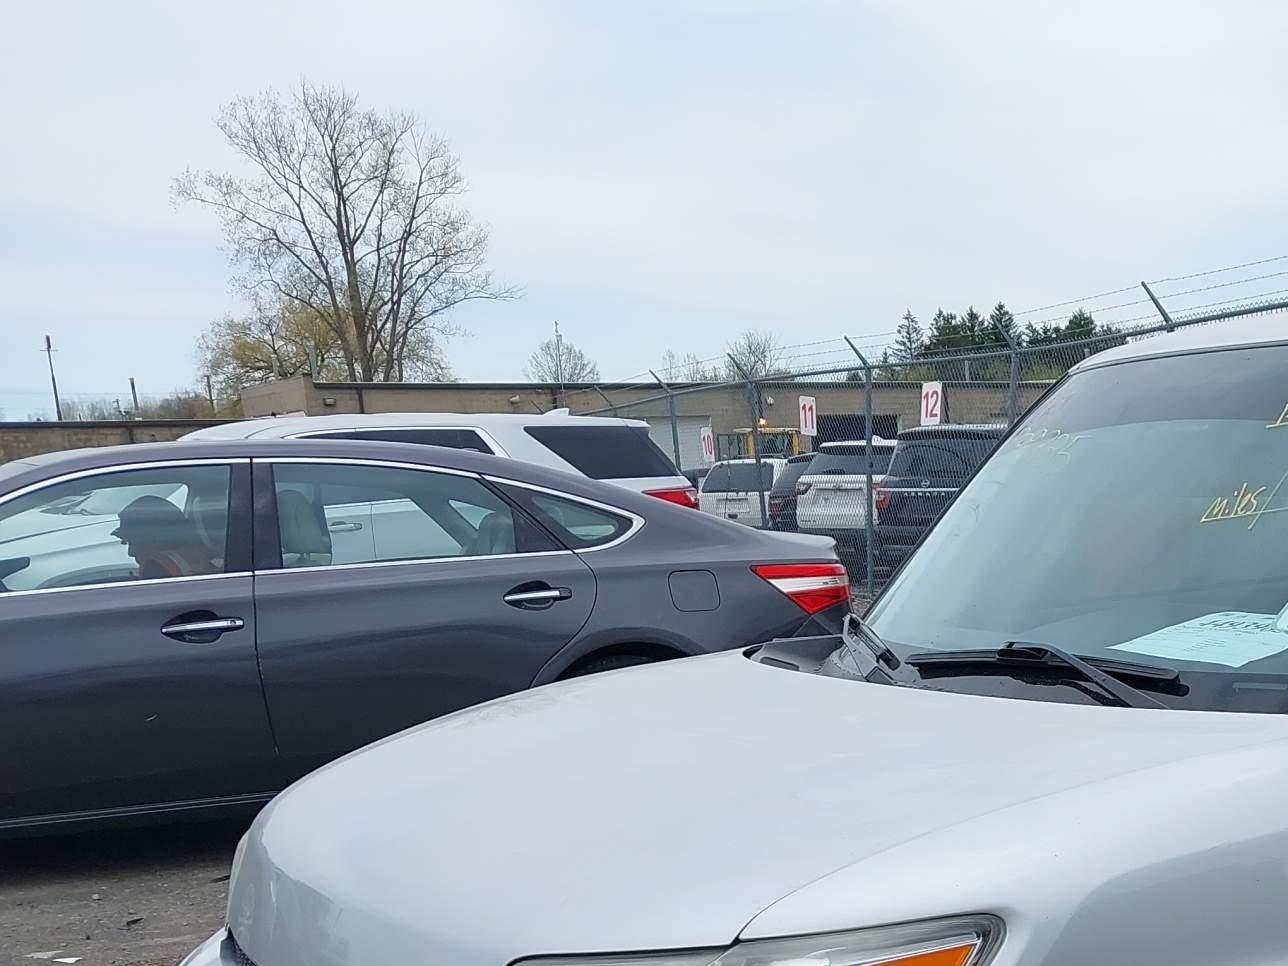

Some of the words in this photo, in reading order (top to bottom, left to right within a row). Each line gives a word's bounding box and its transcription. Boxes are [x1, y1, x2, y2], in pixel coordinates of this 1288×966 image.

[800, 404, 815, 429] 11
[922, 390, 940, 418] 12
[702, 433, 713, 455] 10
